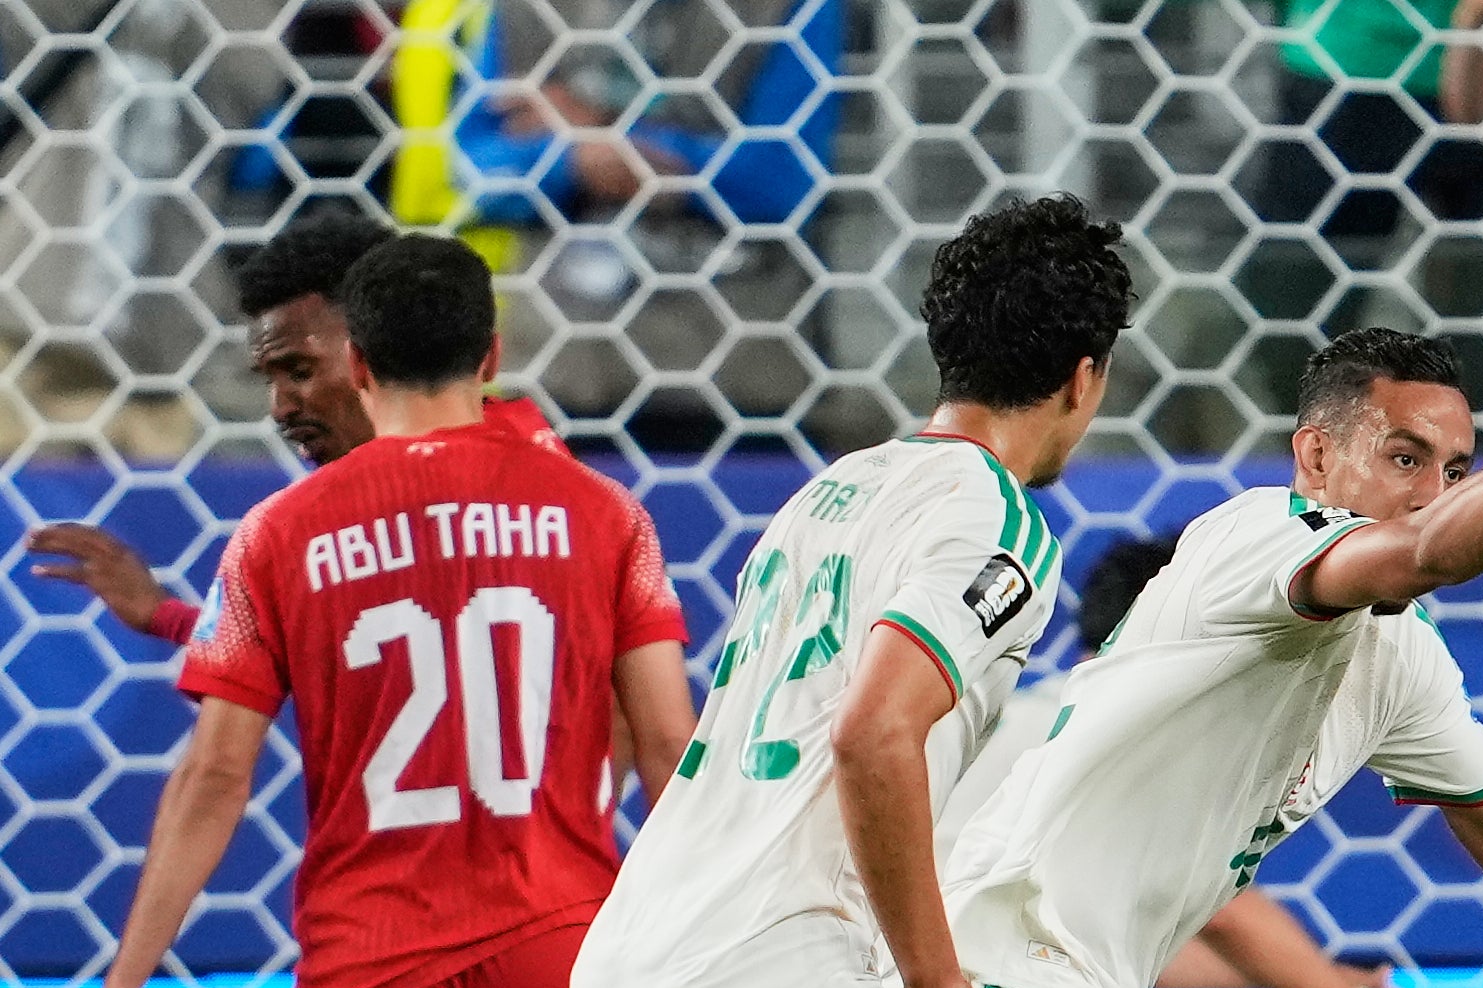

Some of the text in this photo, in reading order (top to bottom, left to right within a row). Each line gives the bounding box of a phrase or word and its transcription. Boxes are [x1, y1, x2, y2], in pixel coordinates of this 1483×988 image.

[305, 502, 571, 592] ABU TAHA
[343, 586, 555, 832] 20
